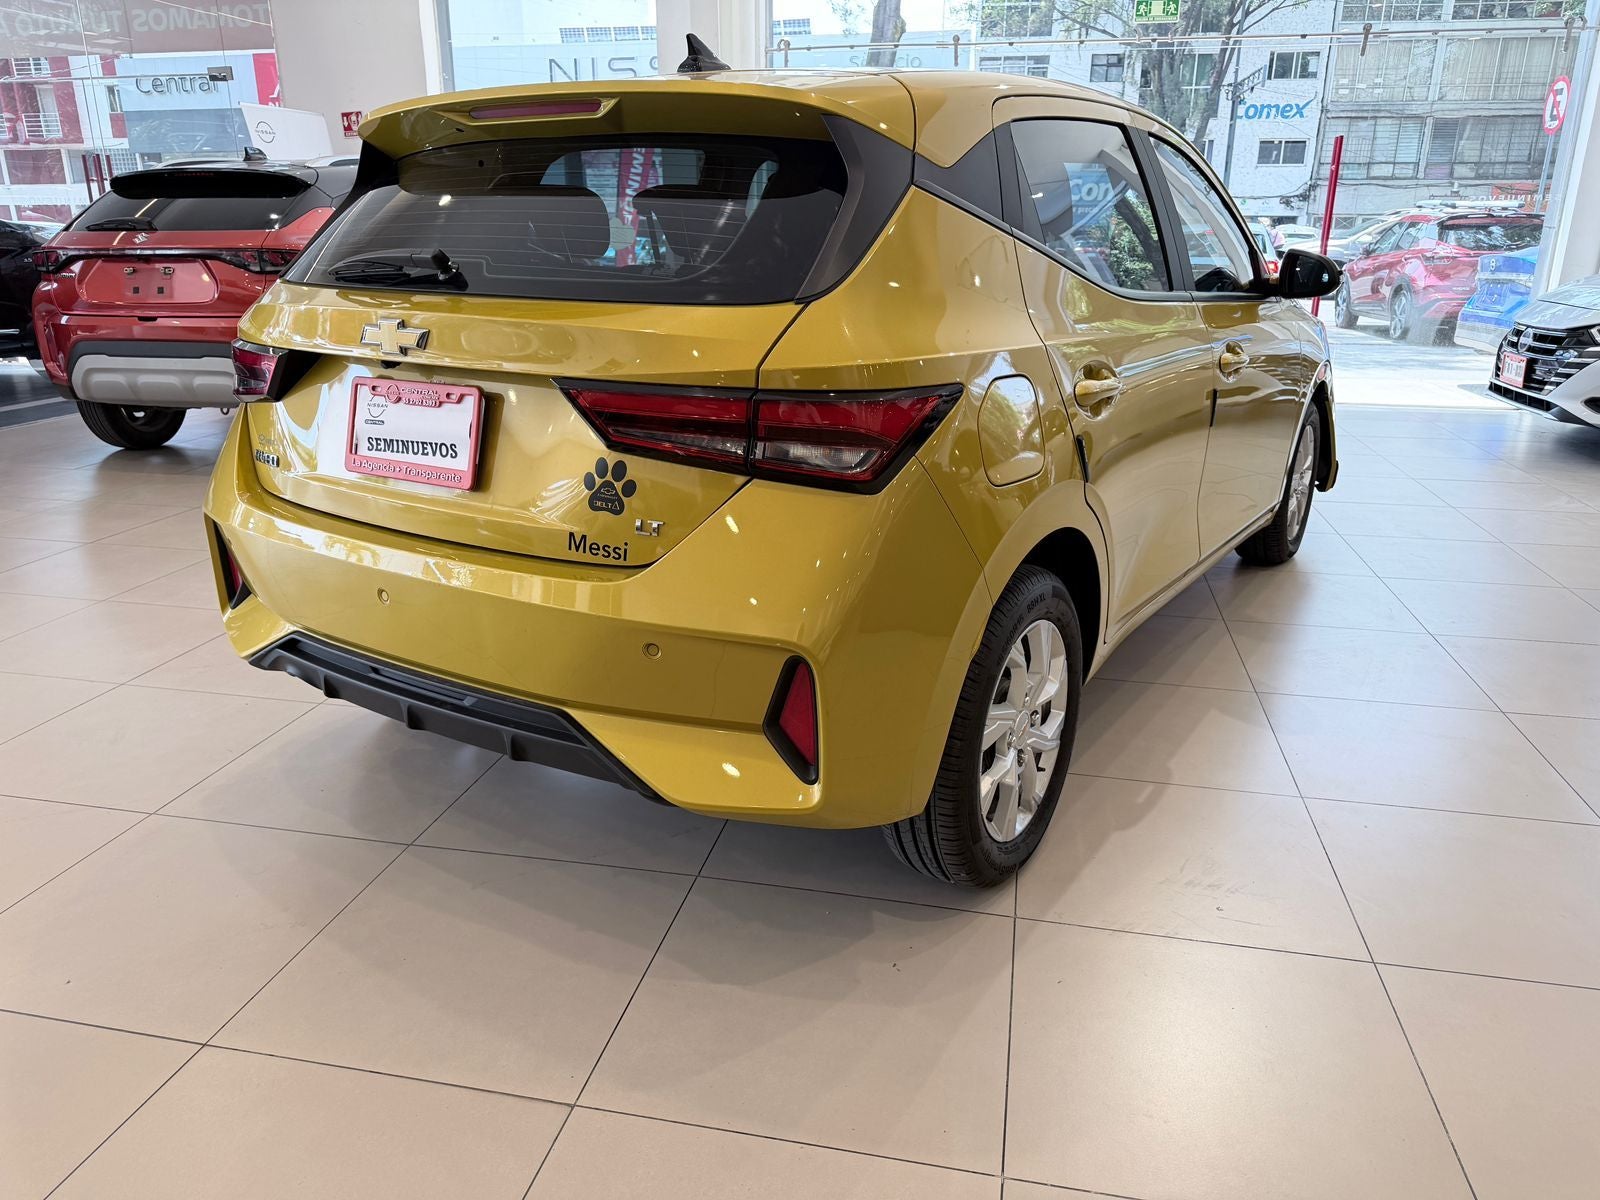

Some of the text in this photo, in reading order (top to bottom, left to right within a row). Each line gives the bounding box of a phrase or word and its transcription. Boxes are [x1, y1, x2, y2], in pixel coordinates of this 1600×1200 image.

[135, 72, 219, 95] Central
[367, 436, 458, 459] SEMINUEVOS
[352, 458, 361, 466] La
[362, 460, 395, 473] Agencia
[403, 465, 462, 483] Transparente
[635, 518, 664, 537] LT
[568, 531, 629, 561] Messi
